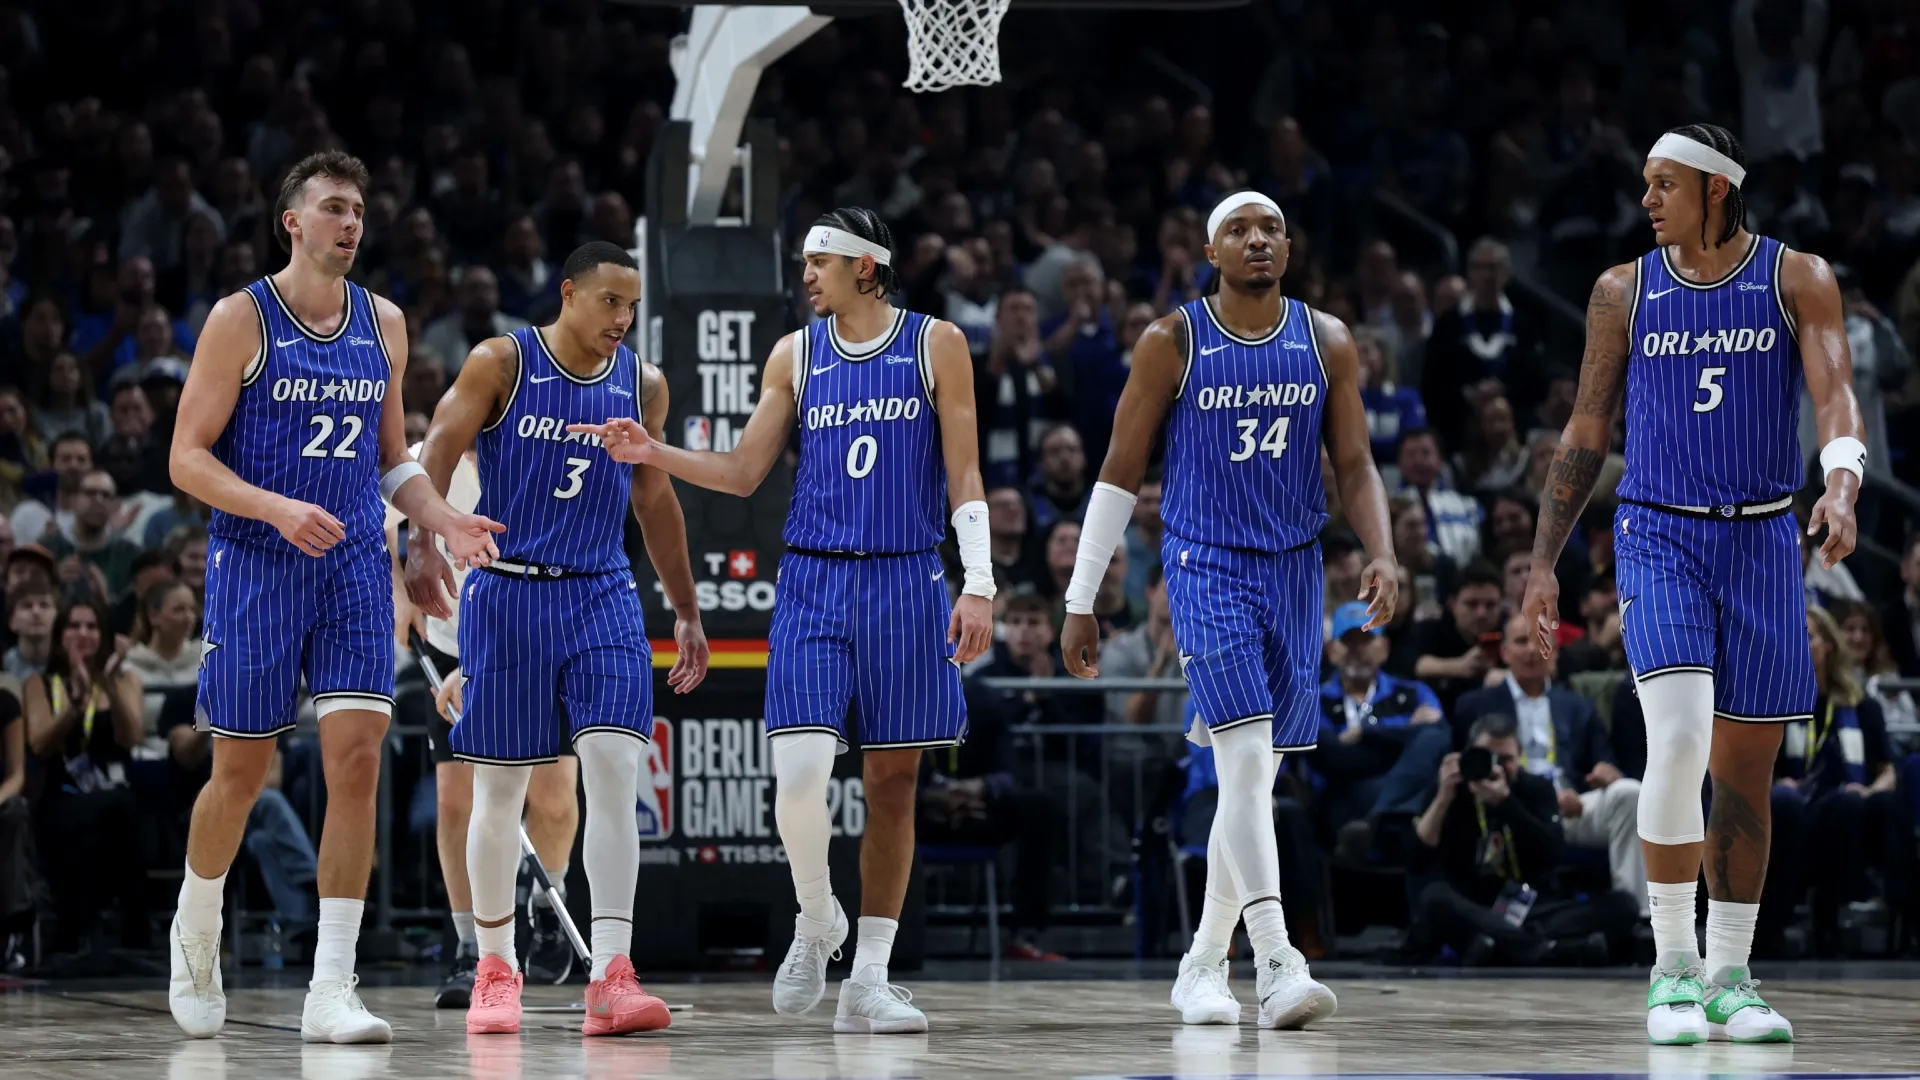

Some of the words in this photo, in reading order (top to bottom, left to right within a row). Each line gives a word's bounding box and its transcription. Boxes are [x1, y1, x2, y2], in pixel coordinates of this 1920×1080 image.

[697, 310, 756, 361] GET
[697, 363, 757, 414] THE
[1693, 367, 1726, 413] 5
[302, 414, 363, 458] 22
[846, 434, 878, 479] 0
[1230, 416, 1290, 462] 34
[553, 457, 592, 500] 3
[681, 719, 776, 777] BERLI
[681, 778, 770, 838] GAME
[718, 844, 789, 864] TISSO
